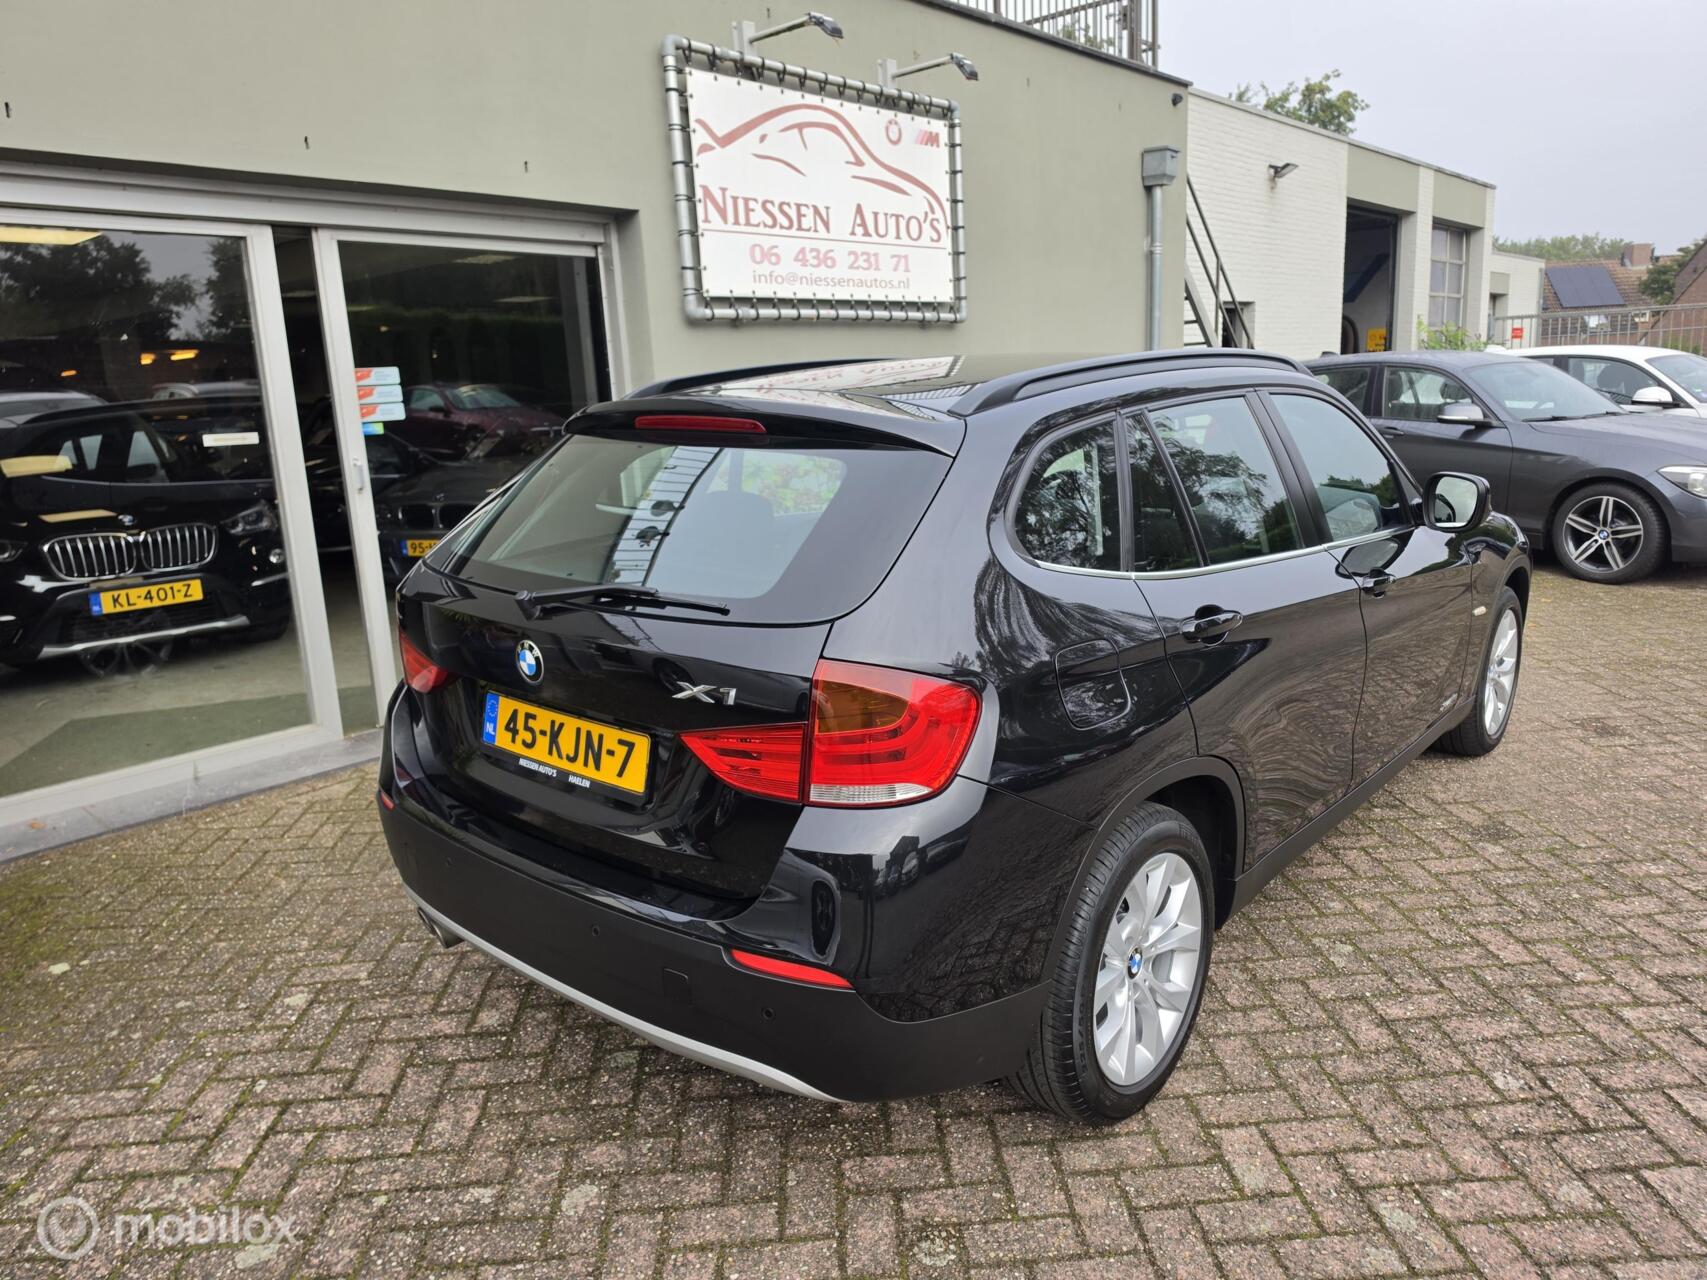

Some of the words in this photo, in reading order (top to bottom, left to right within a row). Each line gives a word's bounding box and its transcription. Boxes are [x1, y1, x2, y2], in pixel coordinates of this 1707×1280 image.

[699, 184, 831, 234] NIESSEN
[849, 203, 942, 243] AUTO'S
[749, 243, 781, 266] 06
[793, 246, 837, 269] 436
[847, 250, 881, 272] 231
[890, 254, 911, 273] 71
[752, 270, 910, 290] info@niessenautos.nl
[111, 583, 193, 609] KL-401-Z
[671, 681, 737, 705] X1
[485, 722, 495, 736] NL
[504, 708, 636, 778] 45-KJN-7
[568, 774, 591, 788] HAELEN
